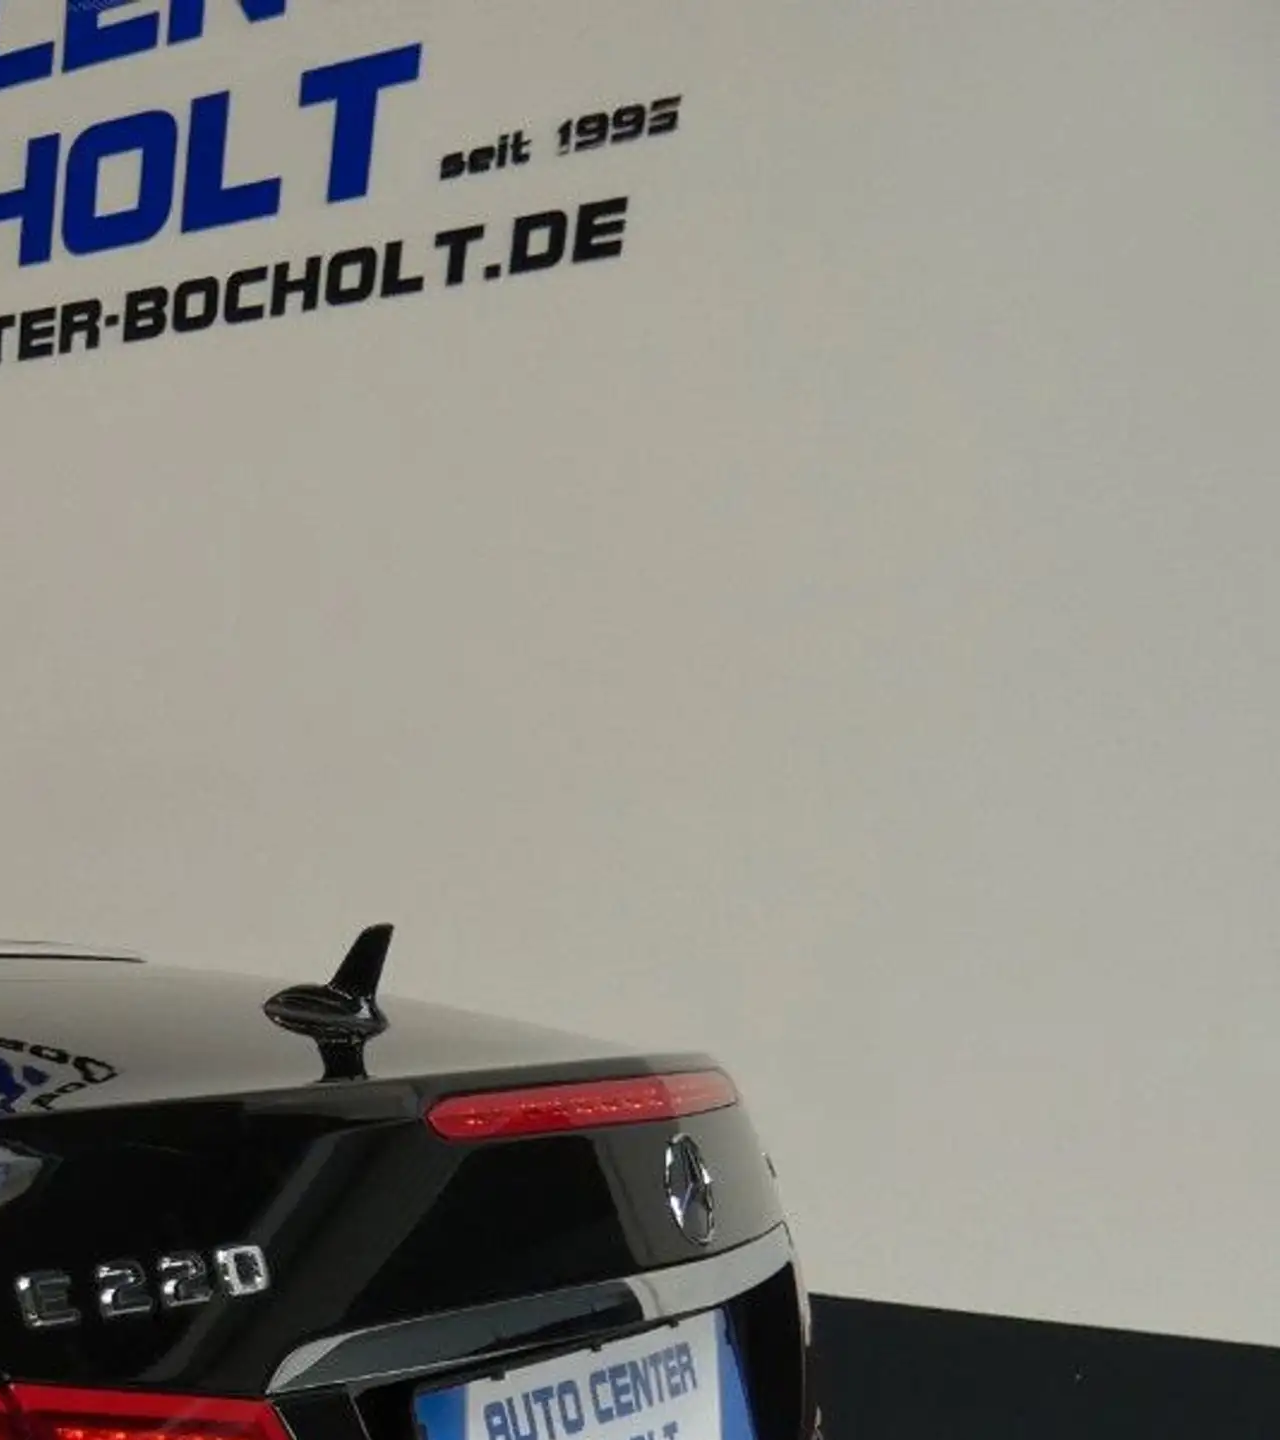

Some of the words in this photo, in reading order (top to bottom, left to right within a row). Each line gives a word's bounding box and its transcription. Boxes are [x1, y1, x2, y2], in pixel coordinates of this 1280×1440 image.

[439, 129, 532, 181] seit
[556, 95, 683, 157] 1995
[15, 1268, 82, 1328] E
[93, 1244, 271, 1320] 220
[589, 1341, 698, 1425] CENTER
